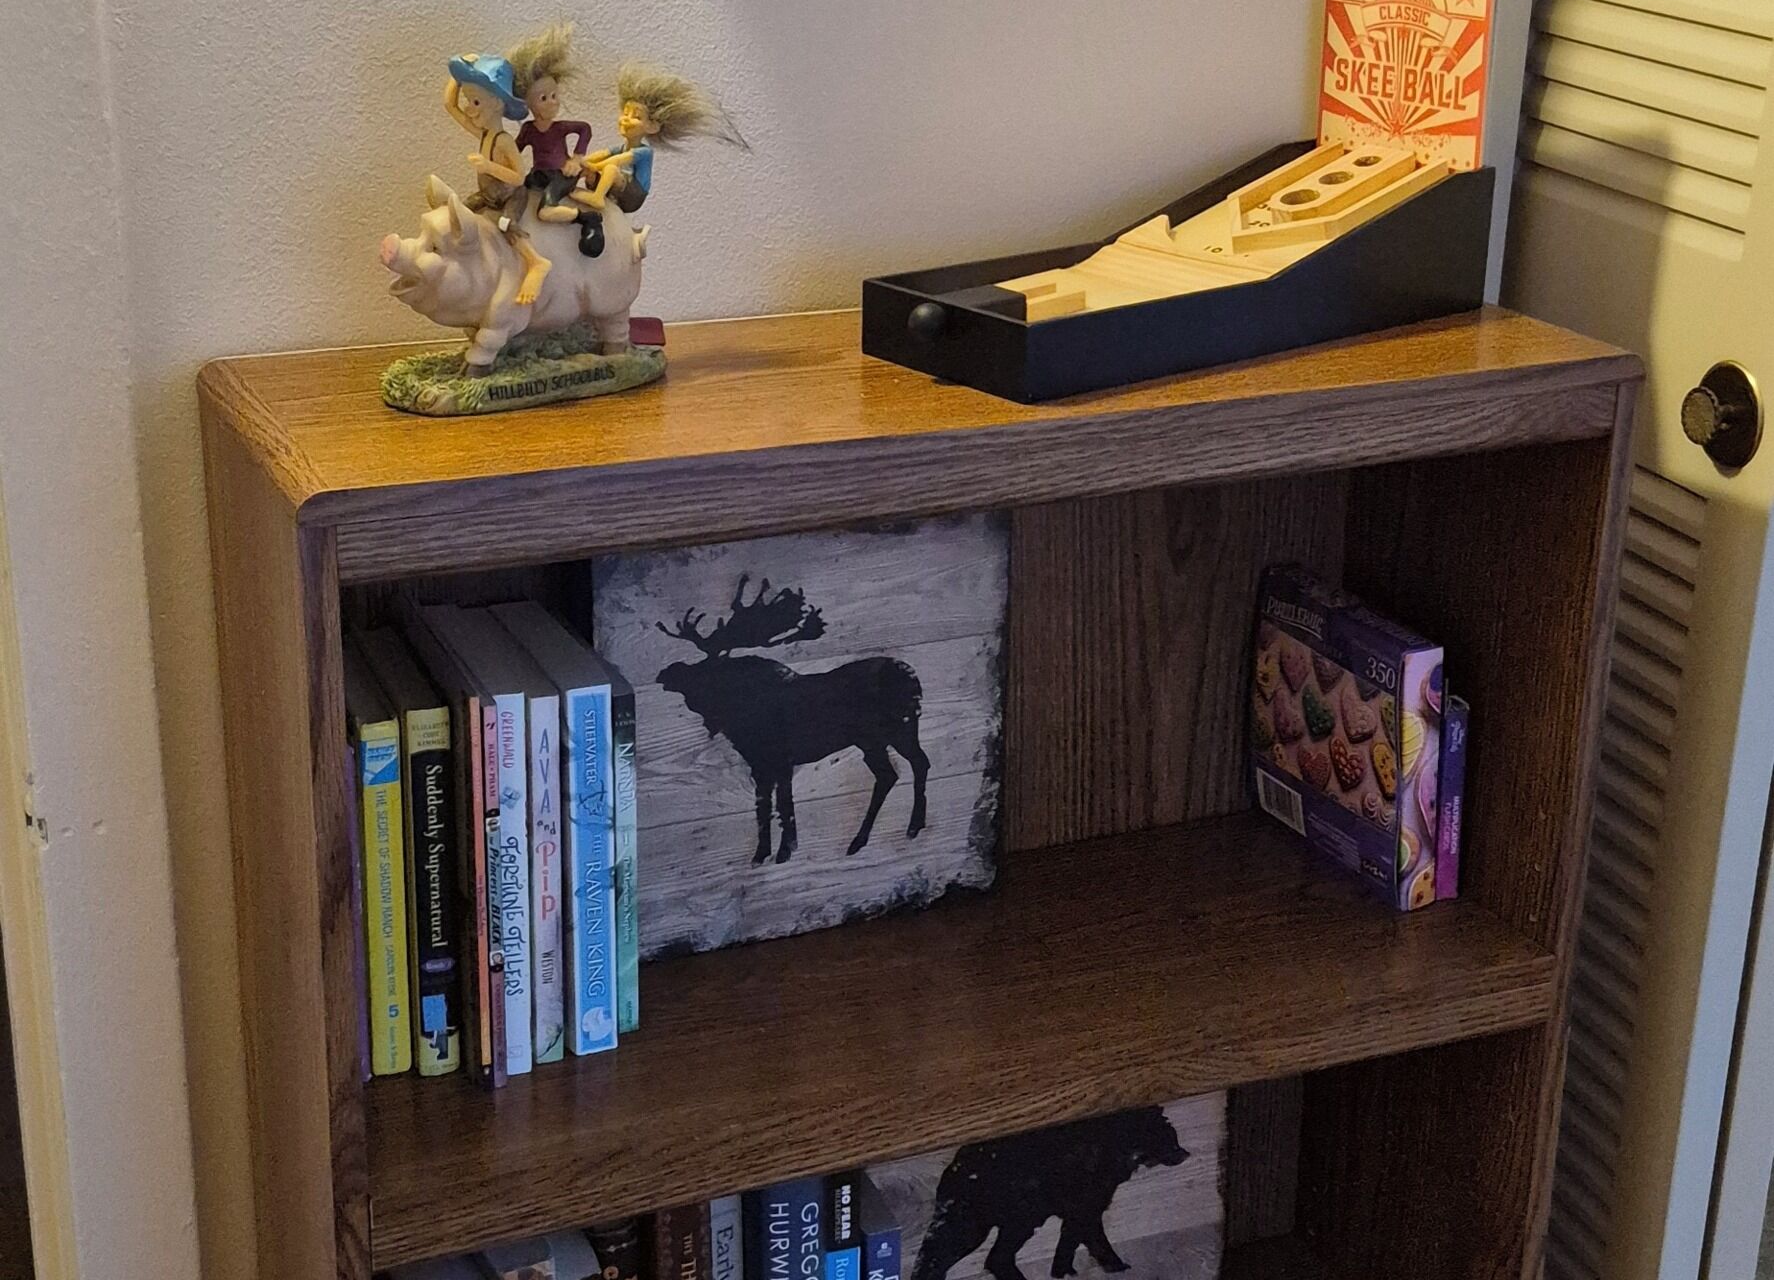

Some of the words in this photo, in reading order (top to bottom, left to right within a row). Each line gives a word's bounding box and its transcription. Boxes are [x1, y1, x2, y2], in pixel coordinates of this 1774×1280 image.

[1379, 5, 1431, 26] CLASSIC
[1334, 57, 1396, 99] SKEE
[1403, 67, 1467, 111] BALL
[1203, 246, 1223, 254] 10
[487, 379, 548, 401] HILLBILLY
[1366, 656, 1397, 690] 350
[501, 711, 515, 769] GREENWALD
[583, 709, 598, 786] STIEFVATER
[539, 728, 550, 814] AVA
[617, 742, 635, 814] NARNIA
[423, 764, 444, 839] Suddenly
[424, 843, 449, 949] Supernatural
[489, 847, 499, 897] Princess
[584, 861, 603, 935] RAVEN
[491, 903, 502, 946] BLACK
[541, 949, 556, 985] WESTON
[587, 943, 606, 998] KING
[388, 1004, 399, 1019] 5
[841, 1184, 851, 1205] NO
[841, 1206, 851, 1240] FEAR
